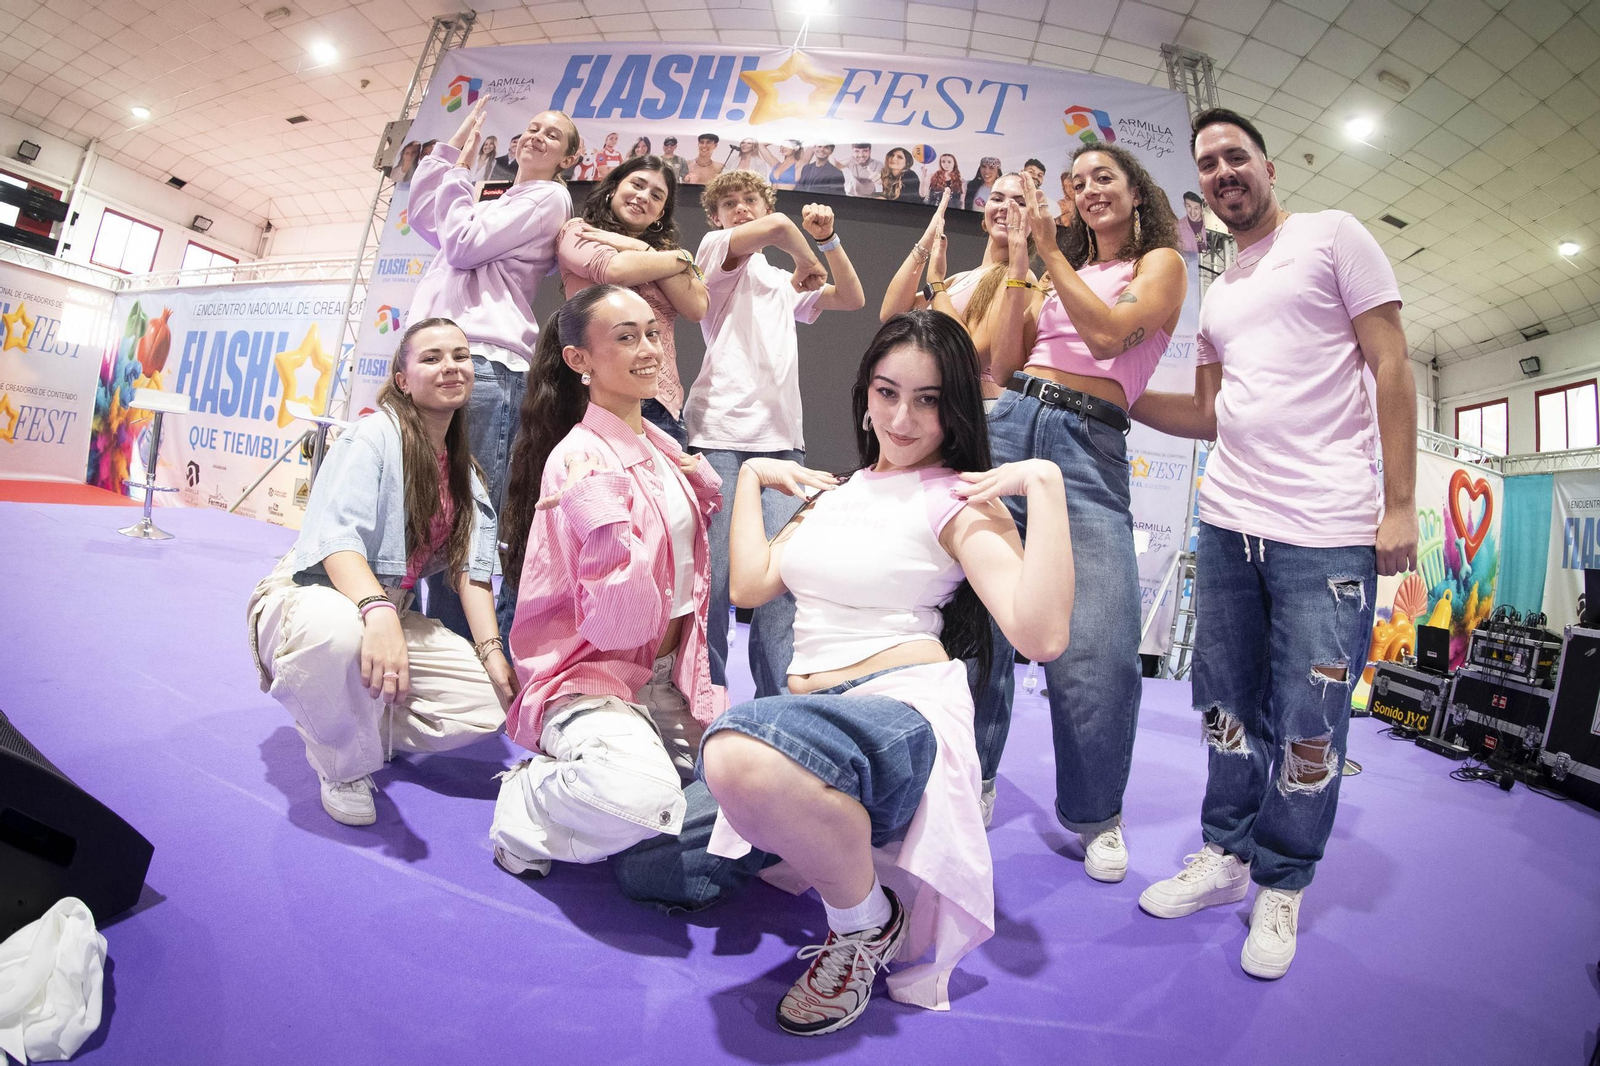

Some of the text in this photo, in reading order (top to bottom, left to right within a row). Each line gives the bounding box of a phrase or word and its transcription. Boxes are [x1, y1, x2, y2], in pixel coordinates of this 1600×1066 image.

[484, 84, 531, 94] AVANZA
[487, 78, 534, 88] ARMILLA
[549, 54, 1028, 136] FLASH! FEST
[1119, 118, 1173, 136] ARMILLA
[1120, 125, 1174, 146] AVANZA
[1120, 137, 1174, 158] contigo
[15, 290, 22, 299] DE
[197, 303, 248, 316] ENCUENTRO
[248, 302, 293, 315] NACIONAL
[295, 301, 309, 315] DE
[176, 330, 289, 422] FLASH!
[6, 383, 38, 395] CREADORXS
[39, 388, 46, 397] DE
[47, 390, 78, 401] CONTENIDO
[10, 405, 77, 444] FEST
[189, 426, 218, 451] QUE
[1147, 460, 1188, 481] FEST
[208, 497, 228, 509] Fermasa
[1132, 521, 1172, 534] ARMILLA
[1373, 700, 1404, 721] Sonido
